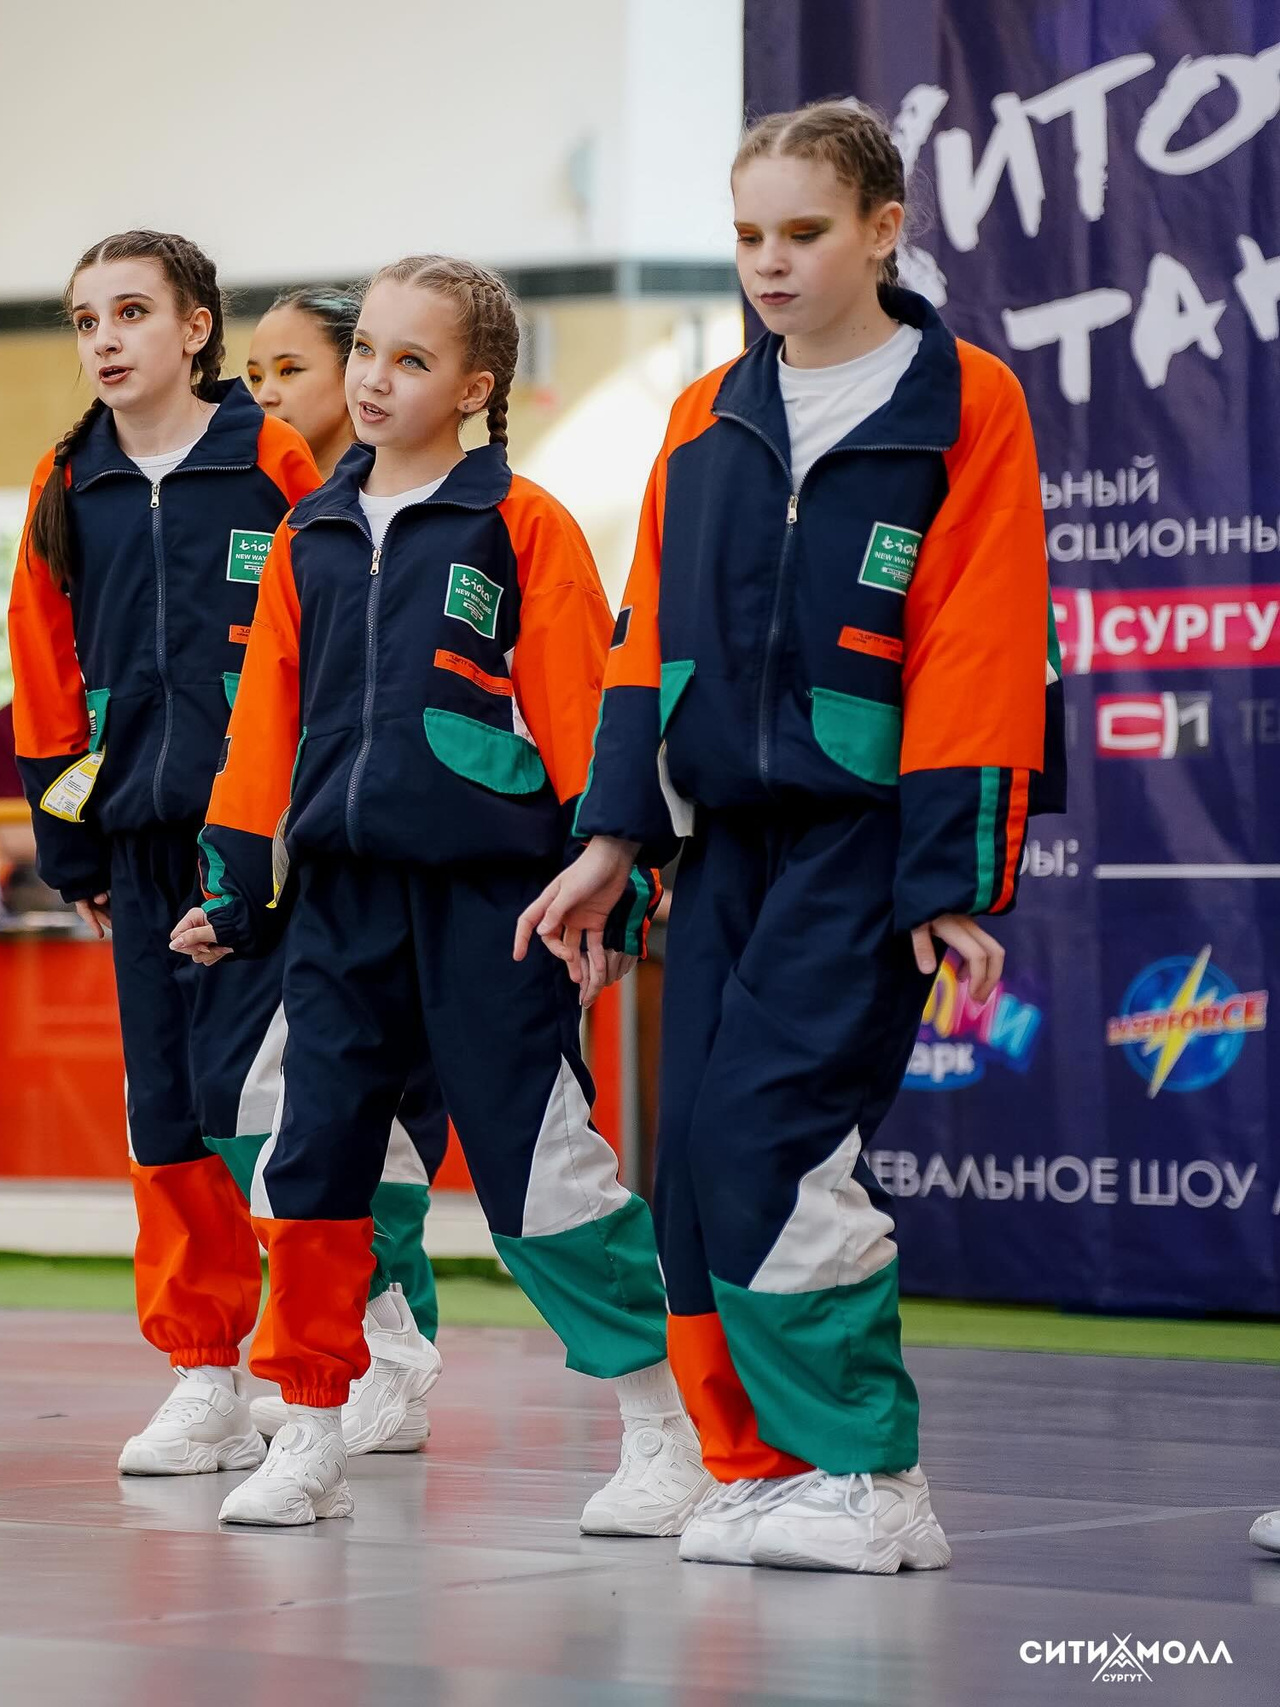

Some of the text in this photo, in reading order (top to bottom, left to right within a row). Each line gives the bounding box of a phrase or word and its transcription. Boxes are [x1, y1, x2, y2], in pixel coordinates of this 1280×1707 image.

[896, 42, 1280, 304] ИТО
[1040, 454, 1159, 510] ьный
[1047, 515, 1280, 564] ационны
[906, 1042, 975, 1083] арк
[862, 1149, 1119, 1204] ЕВАЛЬНОЕ
[1129, 1159, 1258, 1209] ШОУ
